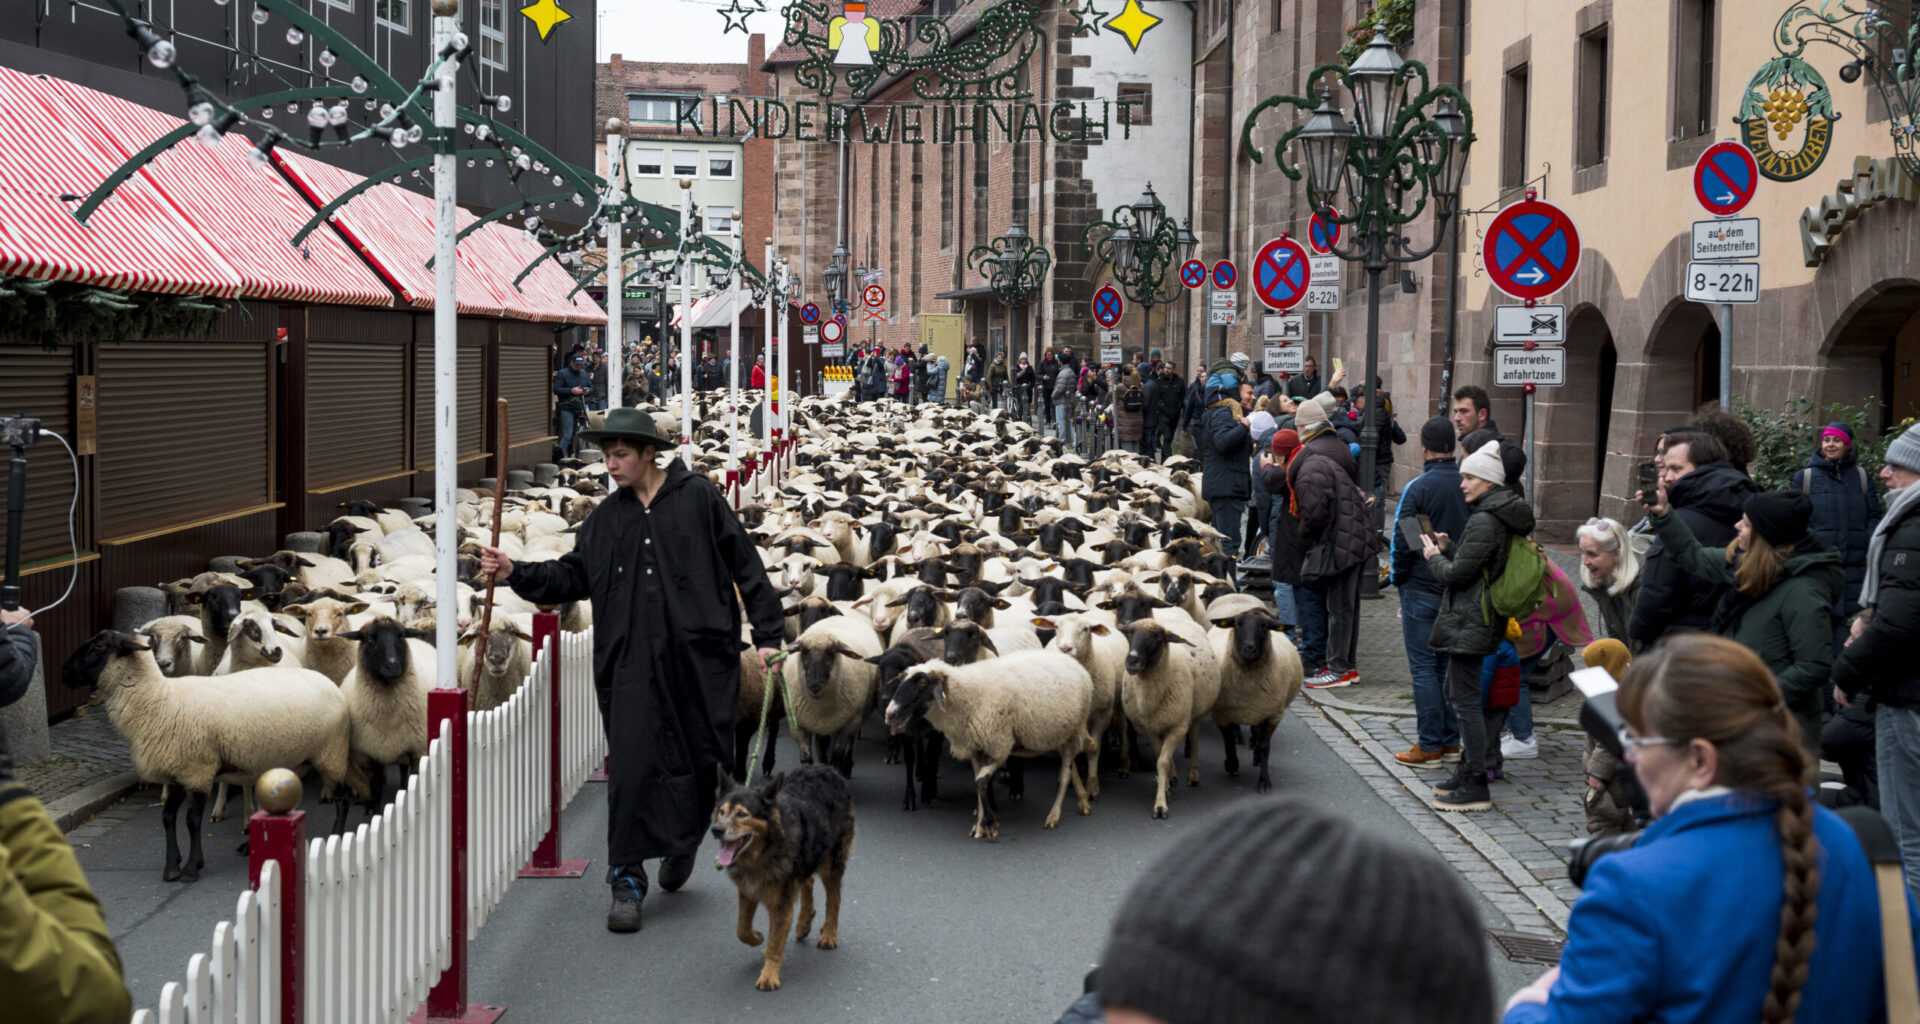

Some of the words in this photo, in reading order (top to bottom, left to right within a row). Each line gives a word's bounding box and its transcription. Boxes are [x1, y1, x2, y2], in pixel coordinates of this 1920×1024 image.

[675, 95, 1144, 144] KINDERWEIHNACHT
[1748, 118, 1829, 177] WEINSTUBEN
[1799, 155, 1920, 268] Restau
[1726, 226, 1743, 238] dem
[1696, 240, 1755, 254] Seitenstreifen
[1323, 260, 1333, 268] dem
[1311, 270, 1338, 278] eitenstreifen
[1694, 273, 1753, 292] 8-22h
[1309, 291, 1338, 304] 8-22h
[1268, 350, 1299, 359] Feuerwehr-
[1503, 354, 1556, 365] Feuerwehr-
[1268, 361, 1300, 369] anfahrtzone
[1503, 369, 1556, 380] anfahrtzone
